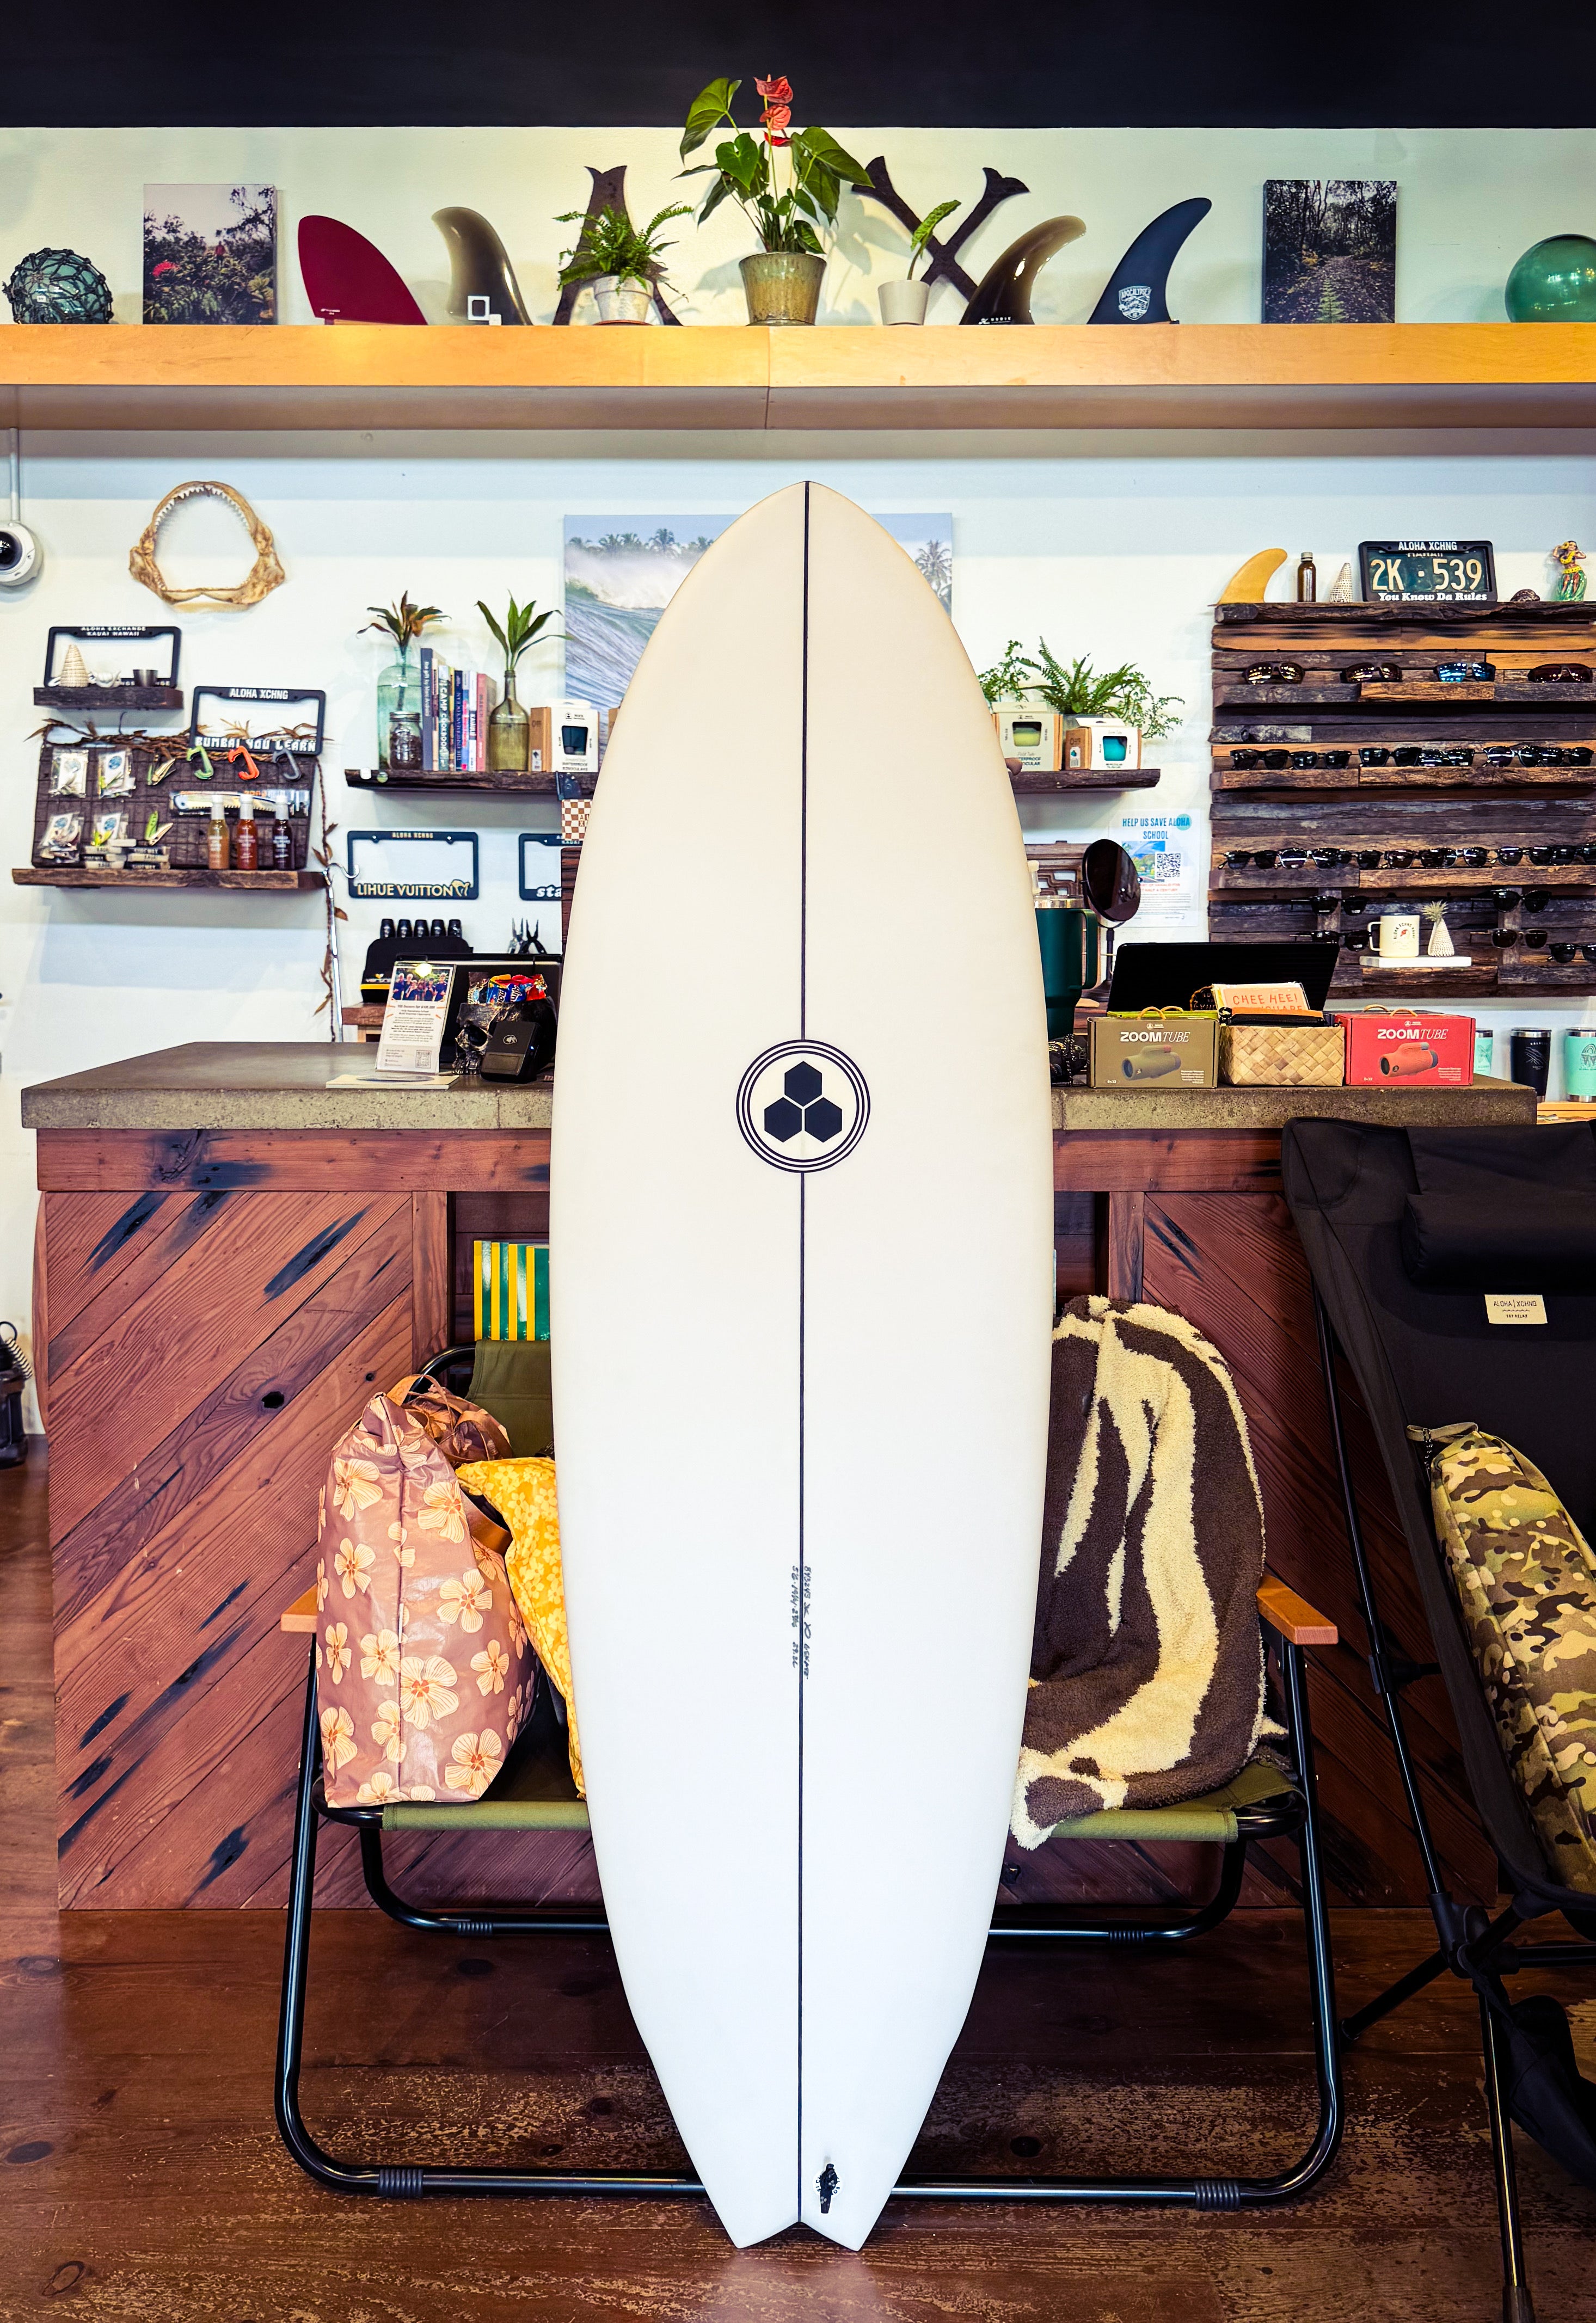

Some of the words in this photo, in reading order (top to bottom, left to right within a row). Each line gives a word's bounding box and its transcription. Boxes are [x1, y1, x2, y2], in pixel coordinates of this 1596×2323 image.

[1398, 542, 1426, 550] ALOHA
[1429, 542, 1457, 550] XCHNG
[1433, 558, 1482, 590] 539
[1378, 592, 1399, 601] You
[1402, 592, 1434, 601] Know
[1437, 592, 1452, 601] Da
[1455, 592, 1487, 601] Rules
[230, 689, 257, 698] ALOHA
[260, 690, 288, 699] XCHNG
[440, 712, 448, 749] COOKBOOK
[195, 736, 240, 748] BUMBAI
[245, 739, 271, 750] YOU
[275, 739, 316, 752] LEARN
[1122, 818, 1139, 827] HELP
[1140, 818, 1149, 826] US
[1150, 818, 1167, 826] SAVE
[1169, 818, 1190, 826] ALOHA
[1143, 831, 1169, 839] SCHOOL
[357, 883, 394, 895] LIHUE
[396, 884, 453, 896] VUITTON
[1233, 994, 1264, 1005] CHEE
[1269, 993, 1298, 1003] HEE!
